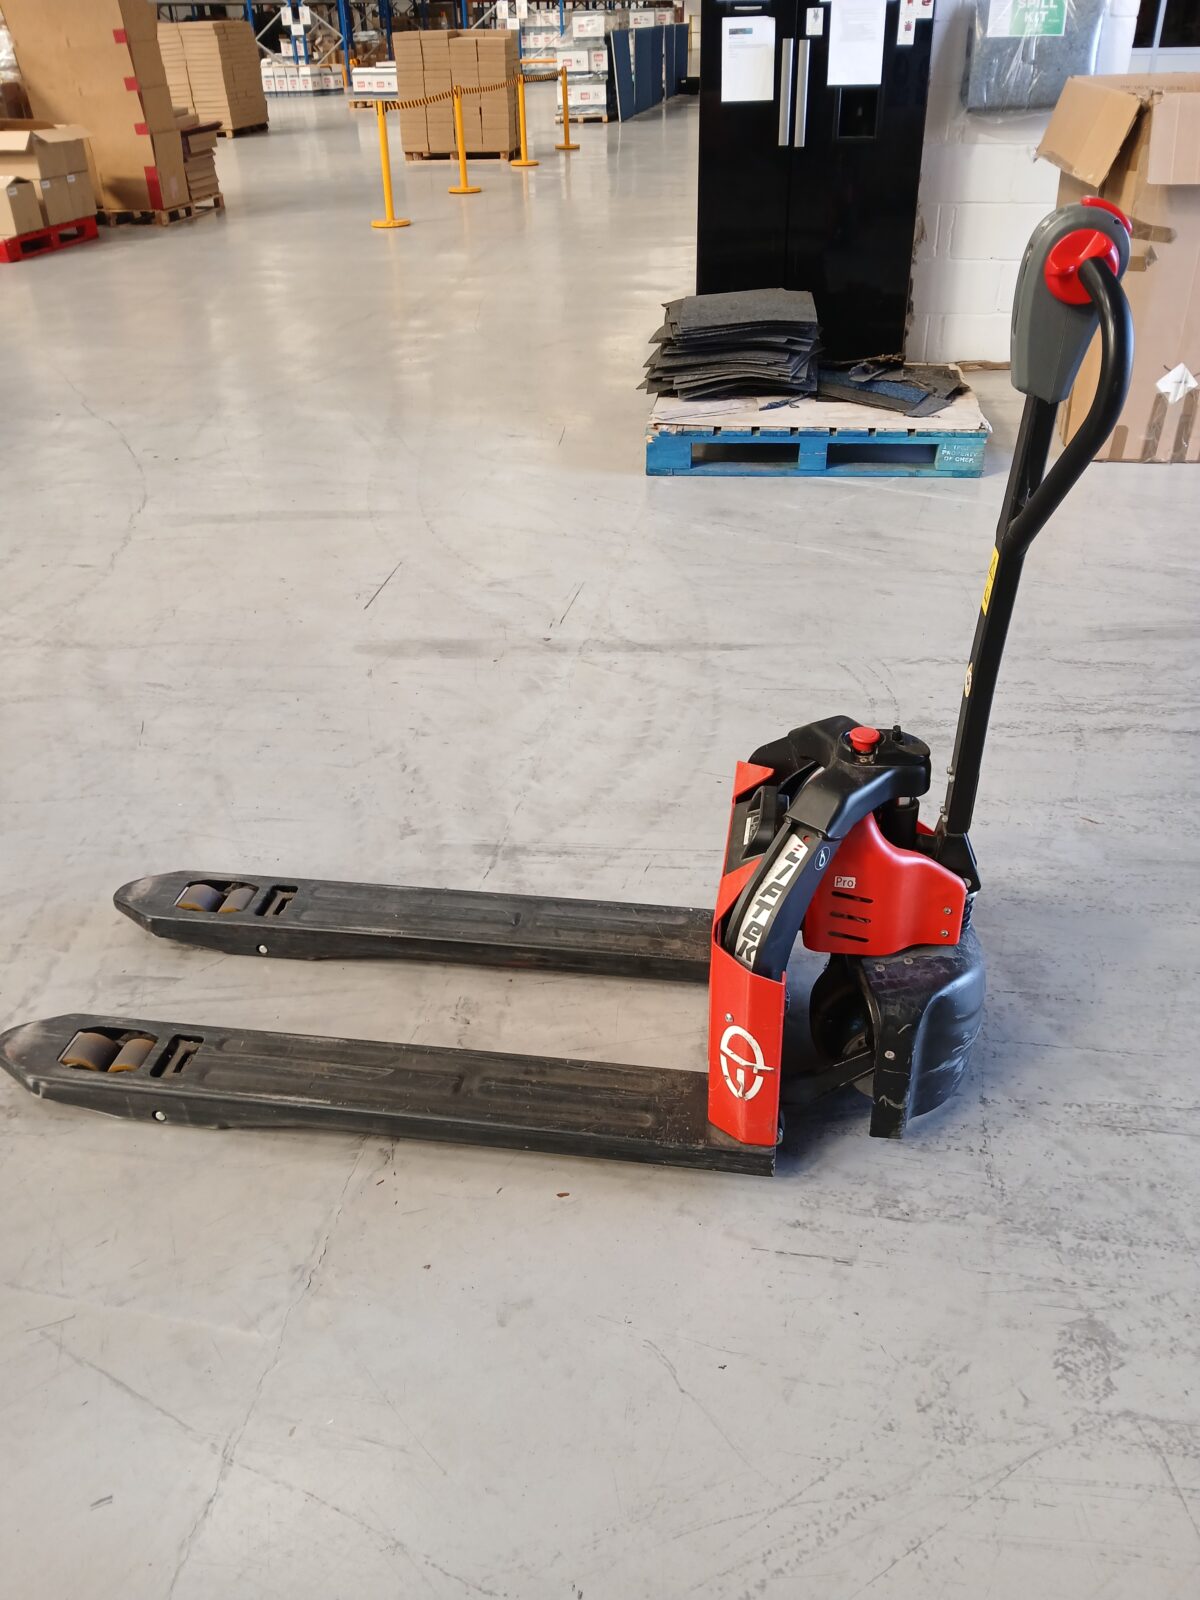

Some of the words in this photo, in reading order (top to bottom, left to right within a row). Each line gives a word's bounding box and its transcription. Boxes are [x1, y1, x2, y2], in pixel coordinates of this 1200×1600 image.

[1017, 0, 1058, 9] SPILL
[1024, 11, 1049, 23] KIT
[835, 877, 854, 888] Pro
